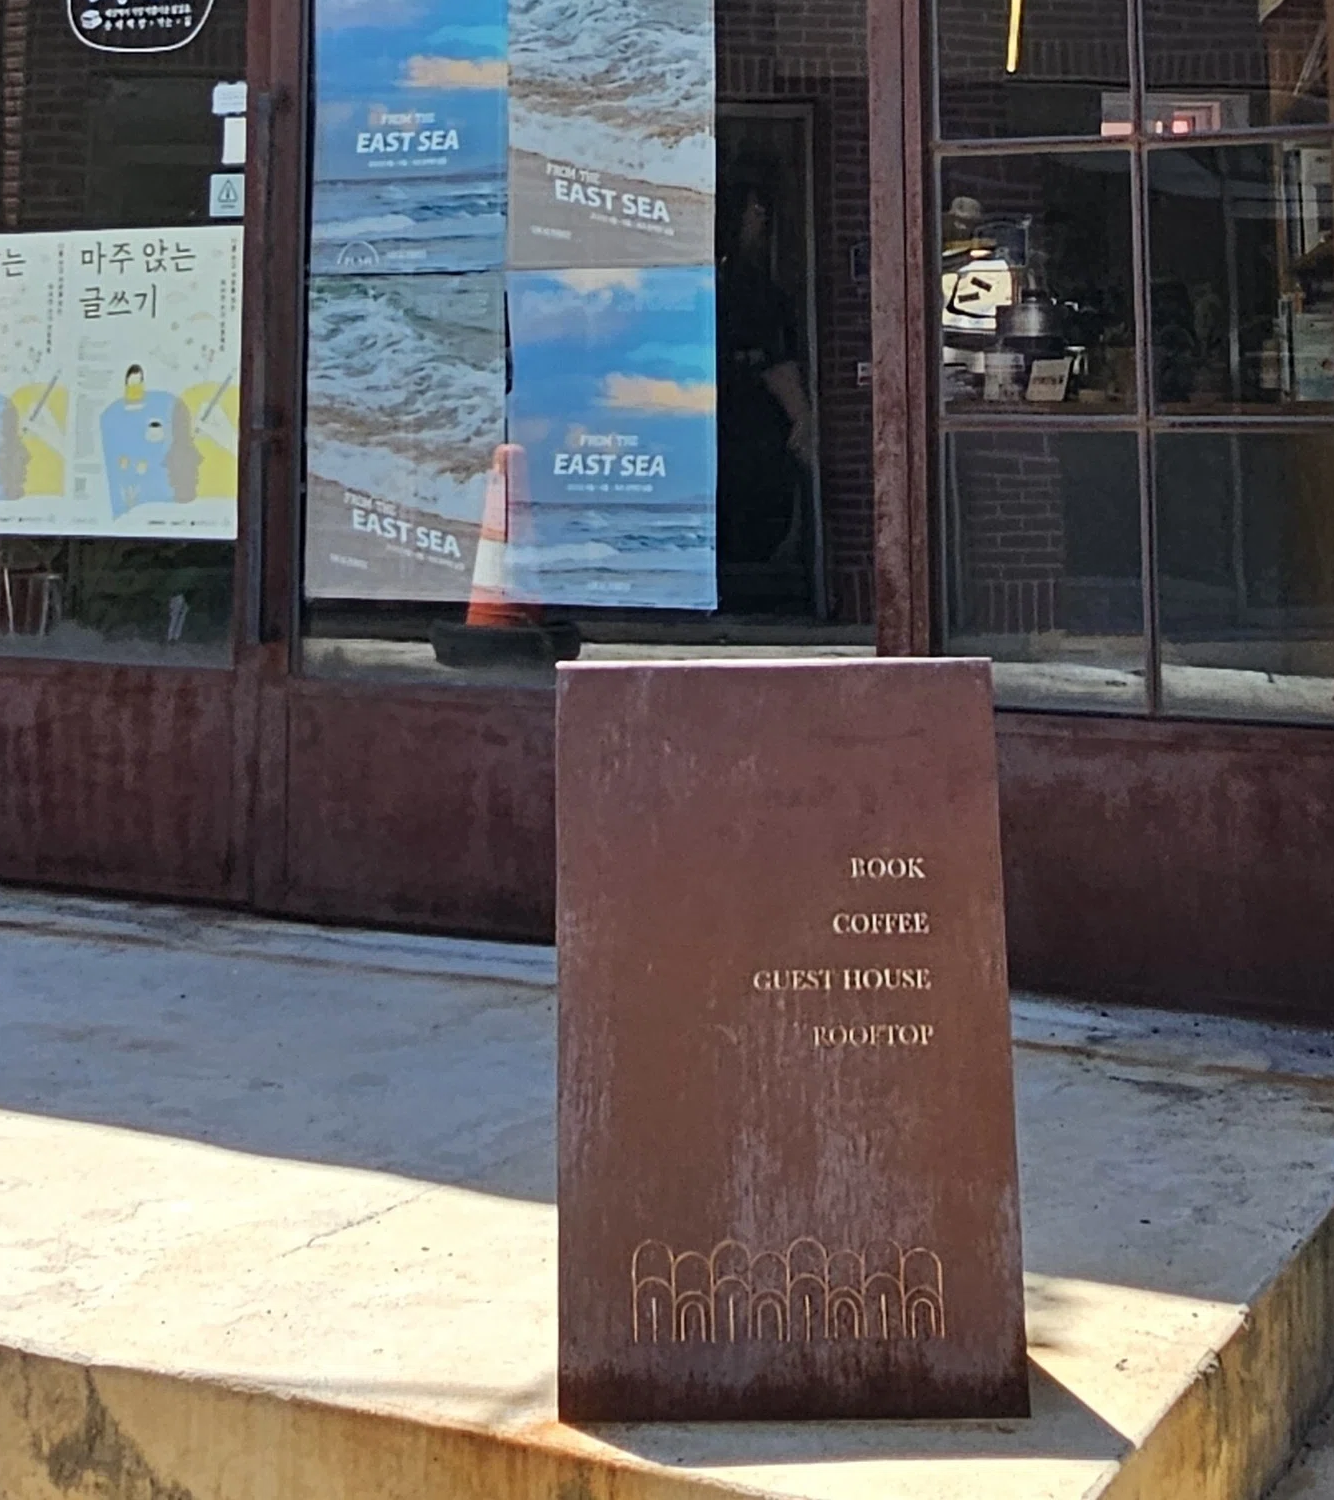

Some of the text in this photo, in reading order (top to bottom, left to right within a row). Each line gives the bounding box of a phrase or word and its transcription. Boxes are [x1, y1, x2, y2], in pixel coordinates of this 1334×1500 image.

[356, 129, 459, 153] EAST SEA
[554, 178, 670, 223] EAST SEA
[80, 240, 135, 275] 마주
[79, 283, 157, 320] 글쓰기
[554, 453, 666, 477] EAST SEA
[352, 508, 414, 544] EAST
[416, 526, 462, 559] SEA
[850, 857, 926, 879] BOOK
[832, 911, 930, 935] COFFEE
[753, 968, 932, 991] GUEST HOUSE
[813, 1024, 934, 1046] ROOFTOP
